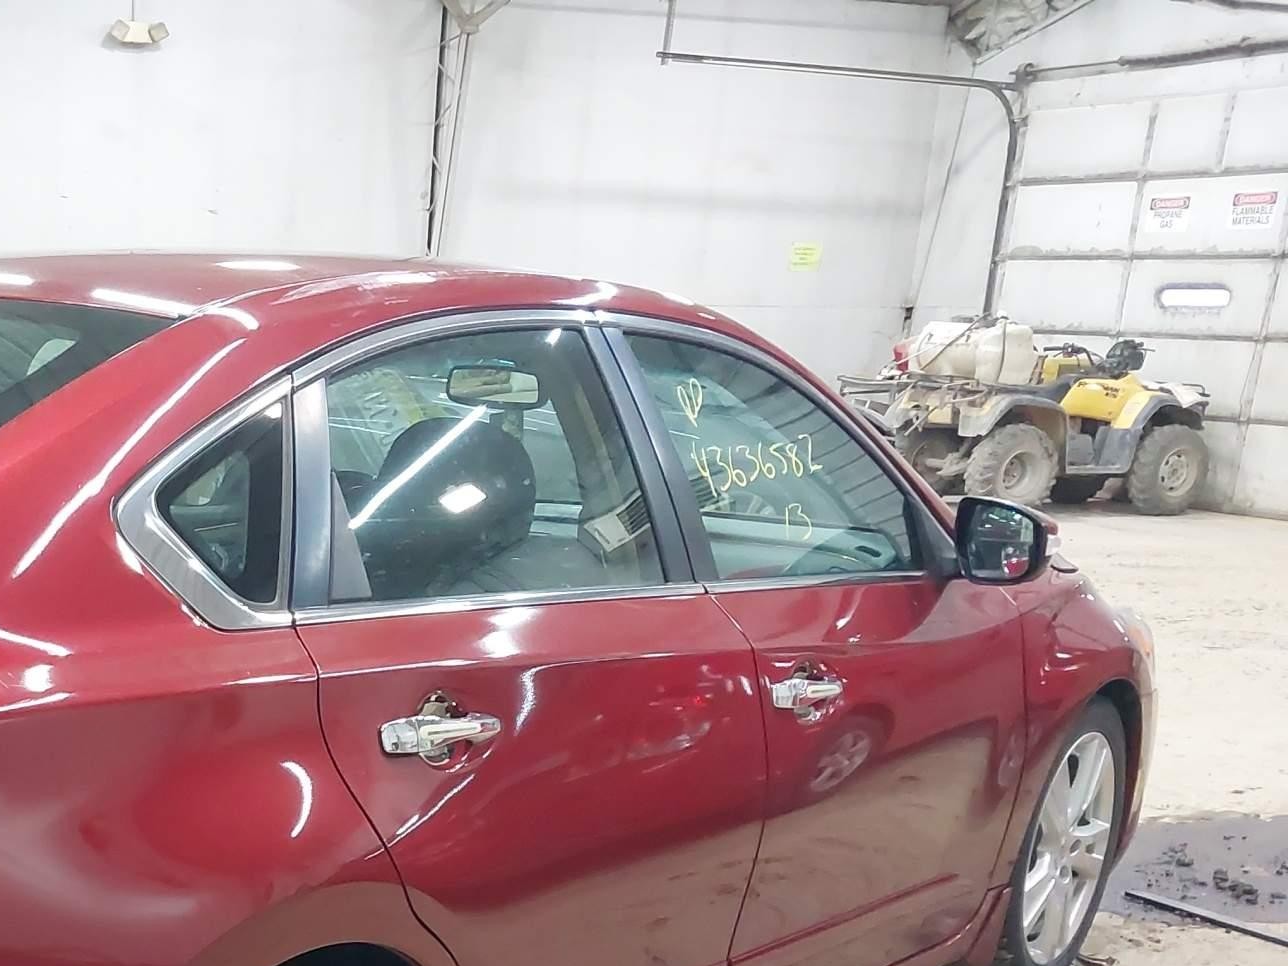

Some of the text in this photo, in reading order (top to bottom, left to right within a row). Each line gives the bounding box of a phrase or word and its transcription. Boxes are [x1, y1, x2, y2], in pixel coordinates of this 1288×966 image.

[1154, 209, 1183, 219] PROPANE
[1232, 205, 1274, 216] FLAMMABLE
[1159, 219, 1173, 229] GAS
[1232, 215, 1271, 226] MATERIALS
[691, 434, 823, 498] 43636582
